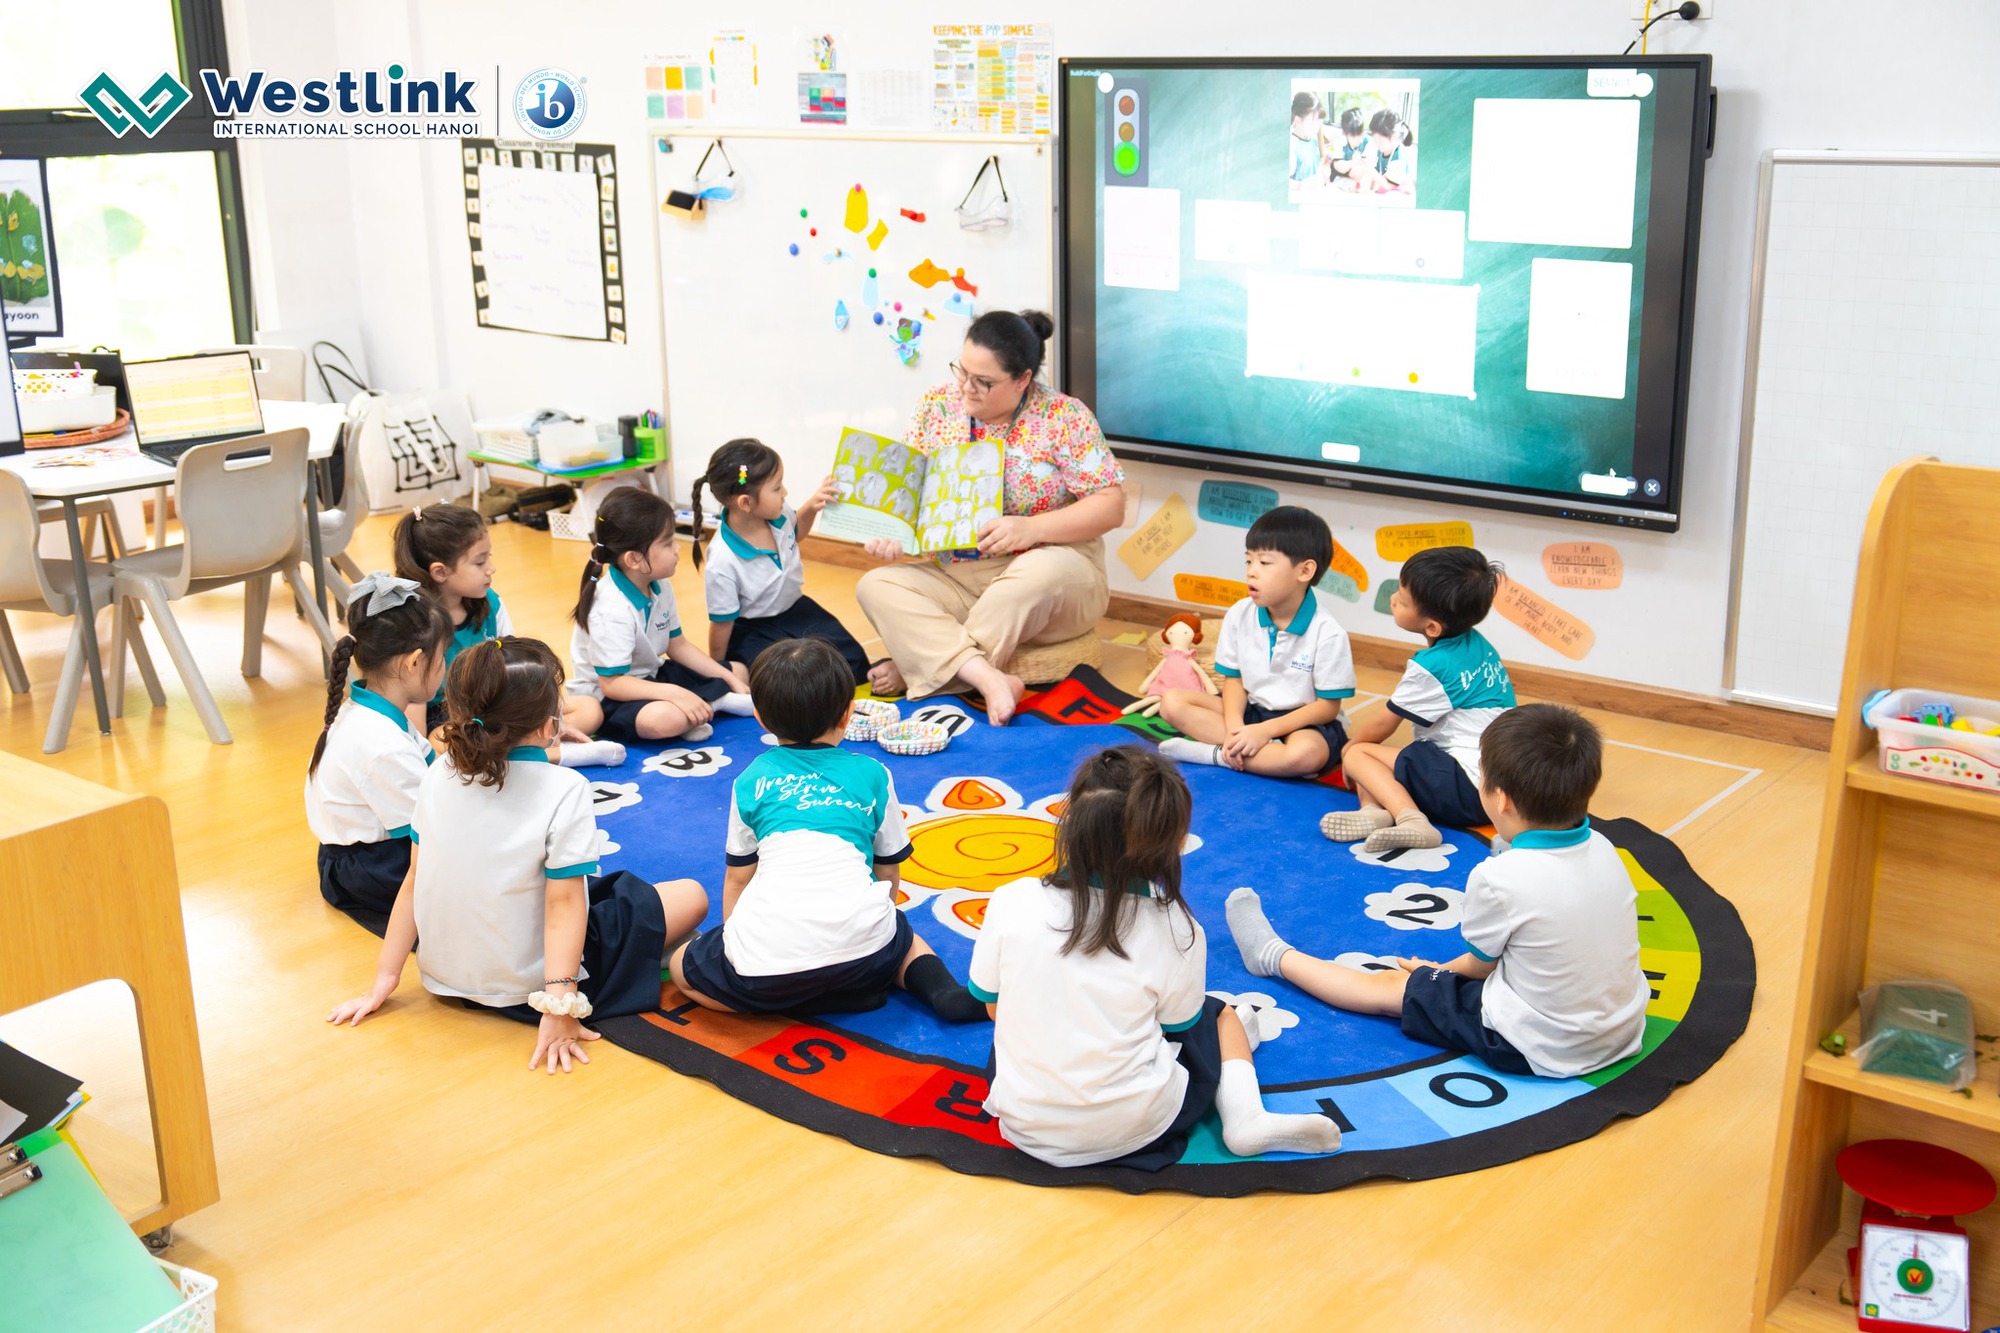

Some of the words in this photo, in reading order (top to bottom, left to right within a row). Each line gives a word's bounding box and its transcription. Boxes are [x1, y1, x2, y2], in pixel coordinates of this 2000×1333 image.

[933, 24, 967, 37] KEEPING
[968, 25, 983, 36] THE
[985, 25, 1000, 37] PYP
[1002, 24, 1034, 36] SIMPLE
[1581, 546, 1592, 554] AM
[1550, 566, 1570, 574] LEARN
[1573, 567, 1587, 576] NEW
[1591, 567, 1617, 577] THINGS
[1562, 576, 1583, 586] EVERY
[1587, 577, 1602, 587] DAY
[1509, 586, 1519, 595] AM
[1552, 614, 1568, 630] TAKE
[1567, 627, 1584, 640] CARE
[1513, 601, 1524, 612] MY
[1561, 634, 1574, 647] AND
[1523, 620, 1543, 636] HEART
[754, 772, 823, 801] Dream
[779, 779, 844, 801] Strive
[1386, 893, 1449, 926] 2
[1898, 1008, 1949, 1025] 4
[773, 1037, 847, 1076] S
